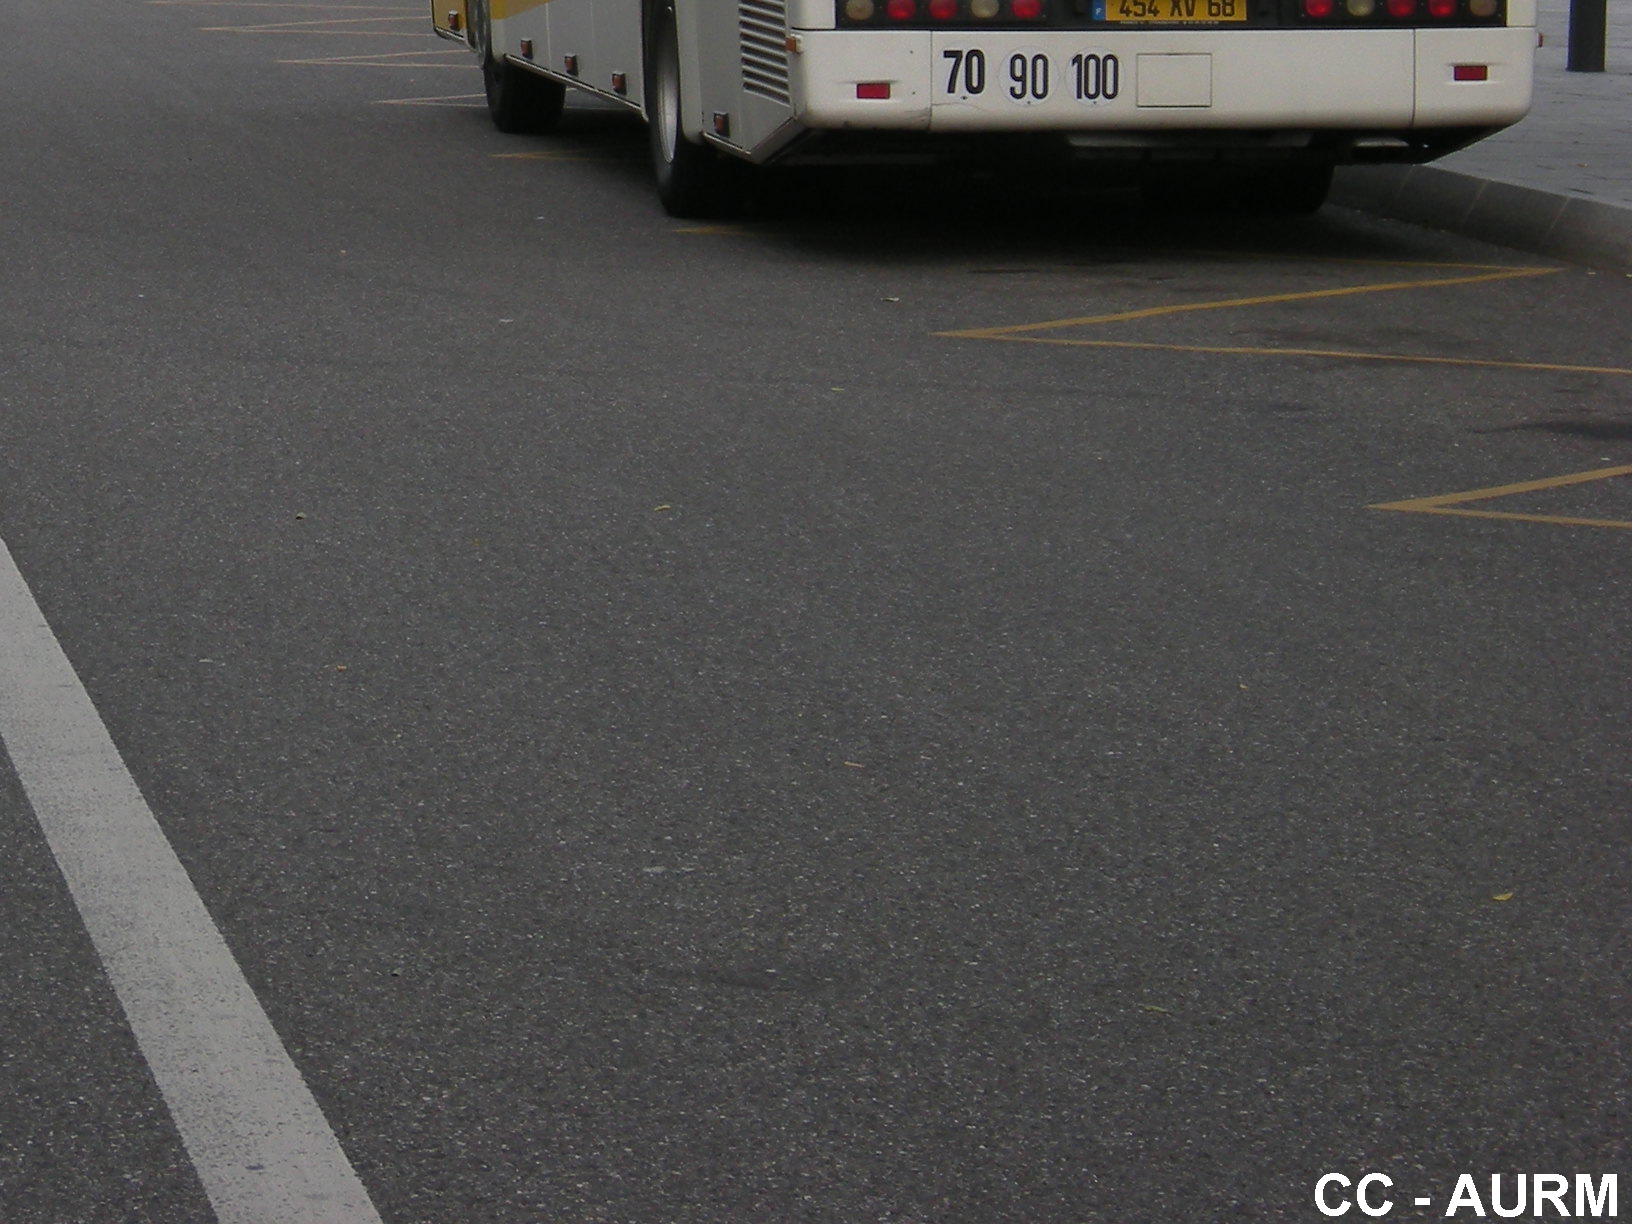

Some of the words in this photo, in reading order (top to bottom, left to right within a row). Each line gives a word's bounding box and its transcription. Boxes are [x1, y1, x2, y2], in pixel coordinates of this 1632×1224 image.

[943, 49, 986, 94] 70
[1009, 53, 1049, 100] 90
[1072, 53, 1119, 100] 100
